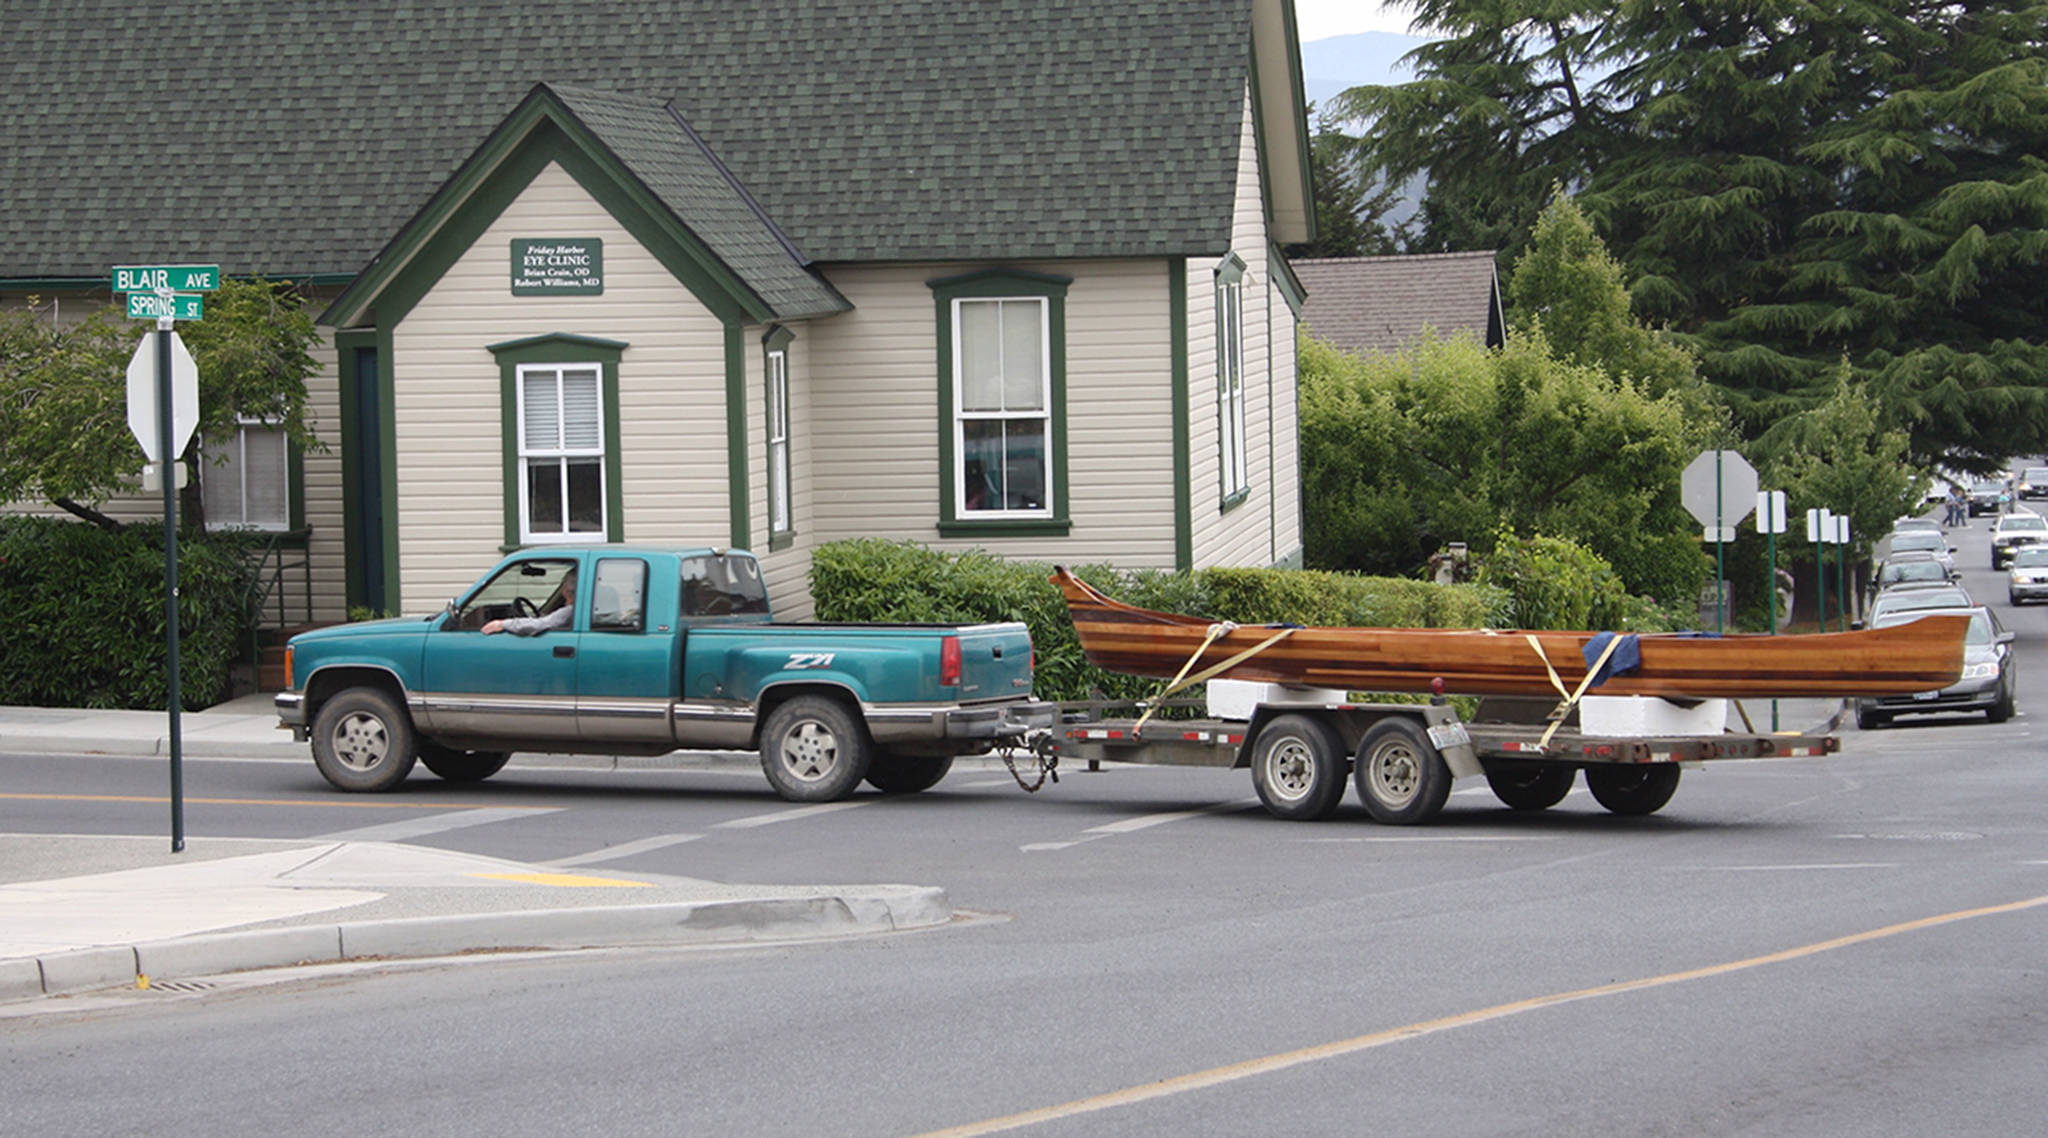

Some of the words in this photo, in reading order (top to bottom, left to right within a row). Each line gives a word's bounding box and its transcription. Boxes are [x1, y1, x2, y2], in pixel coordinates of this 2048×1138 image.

[528, 246, 555, 255] Friday
[556, 246, 586, 254] Harbor
[524, 256, 545, 265] EYE
[547, 255, 590, 265] CLINIC
[524, 268, 545, 276] Brian
[574, 268, 590, 276] OD
[118, 270, 168, 288] BLAIR
[186, 273, 211, 287] AVE
[514, 278, 542, 287] Robert
[583, 278, 599, 286] MD
[131, 296, 175, 315] SPRING
[783, 653, 835, 669] Z71
